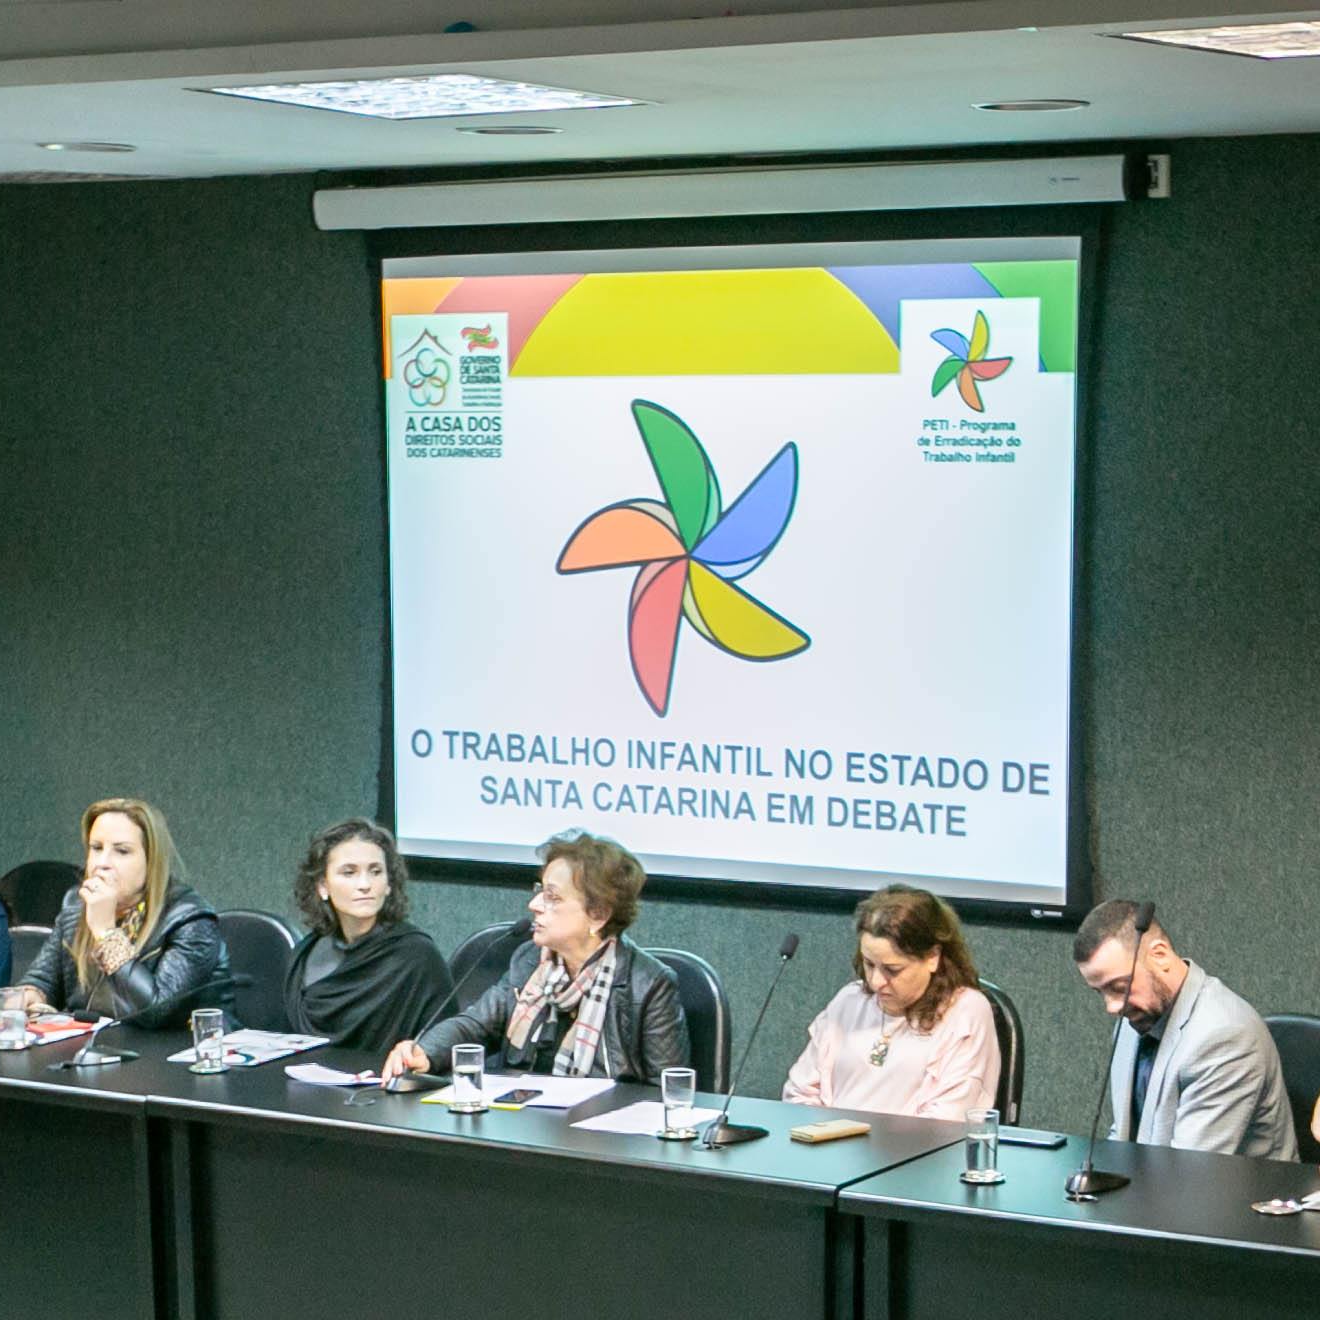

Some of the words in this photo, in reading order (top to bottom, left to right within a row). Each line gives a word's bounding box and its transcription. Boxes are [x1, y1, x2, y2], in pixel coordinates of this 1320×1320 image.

[405, 416, 417, 432] A
[420, 416, 464, 432] CASA
[468, 416, 502, 432] DOS
[922, 419, 949, 430] PETI
[959, 419, 1016, 434] Programa
[405, 434, 456, 446] DIREITOS
[458, 434, 503, 446] SOCIAIS
[934, 435, 1003, 449] Erradicação
[406, 447, 428, 459] DOS
[431, 447, 502, 458] CATARINENSES
[922, 450, 972, 462] Trabalho
[975, 451, 1016, 462] Infantil
[410, 728, 434, 759] O
[442, 730, 617, 768] TRABALHO
[627, 739, 773, 777] INFANTIL
[784, 748, 833, 781] NO
[845, 751, 989, 791] ESTADO
[1001, 761, 1050, 796] DE
[479, 775, 584, 811] SANTA
[592, 782, 757, 822] CATARINA
[766, 792, 814, 826] EM
[827, 796, 967, 837] DEBATE
